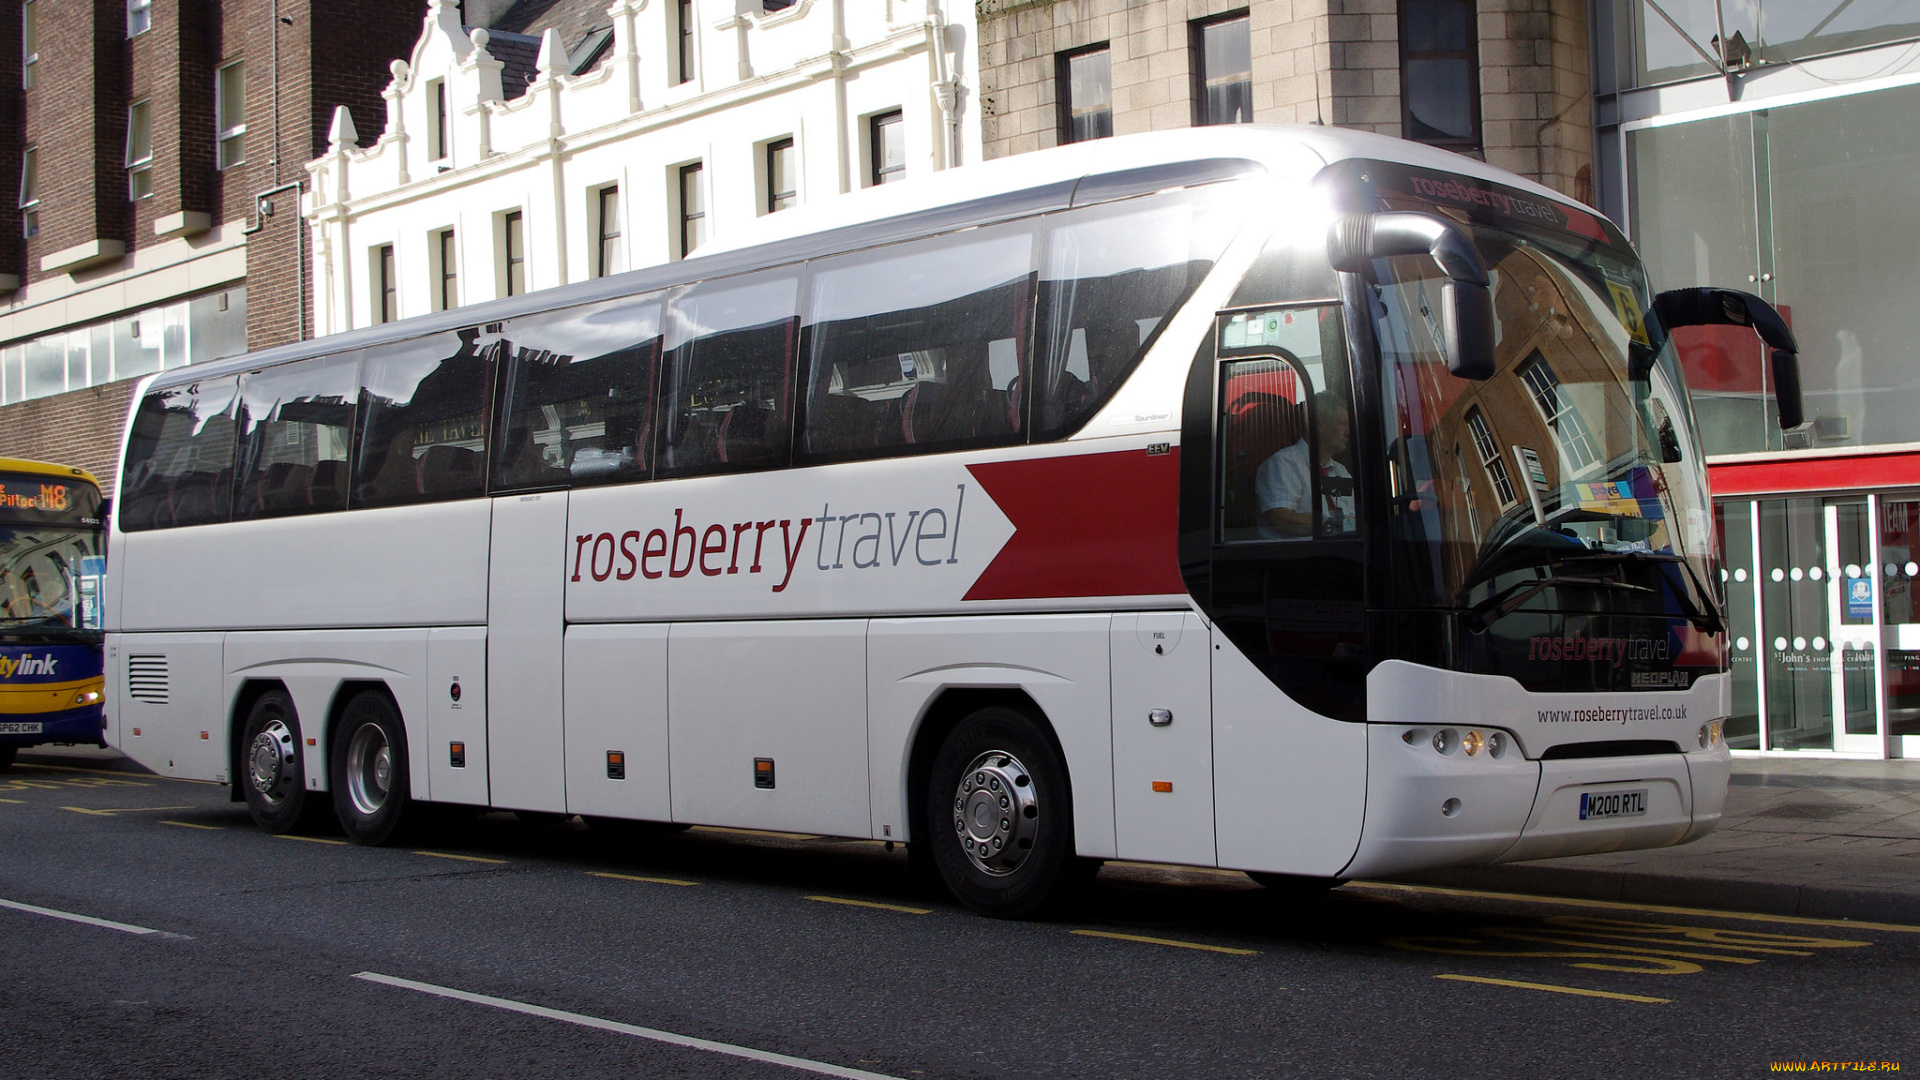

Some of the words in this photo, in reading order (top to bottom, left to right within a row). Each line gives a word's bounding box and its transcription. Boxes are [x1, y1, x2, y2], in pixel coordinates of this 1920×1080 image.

[1134, 413, 1169, 422] Tourliner
[1148, 444, 1169, 454] EEV
[41, 484, 67, 509] M8
[1882, 503, 1908, 533] TEAM
[571, 484, 965, 593] roseberrytravel
[1782, 652, 1811, 664] John's
[1631, 671, 1689, 687] NEOPLAN
[1538, 704, 1687, 725] www.roseberrytravel.co.uk
[21, 723, 39, 732] CHK
[1588, 795, 1619, 816] M200
[1622, 792, 1644, 813] RTL
